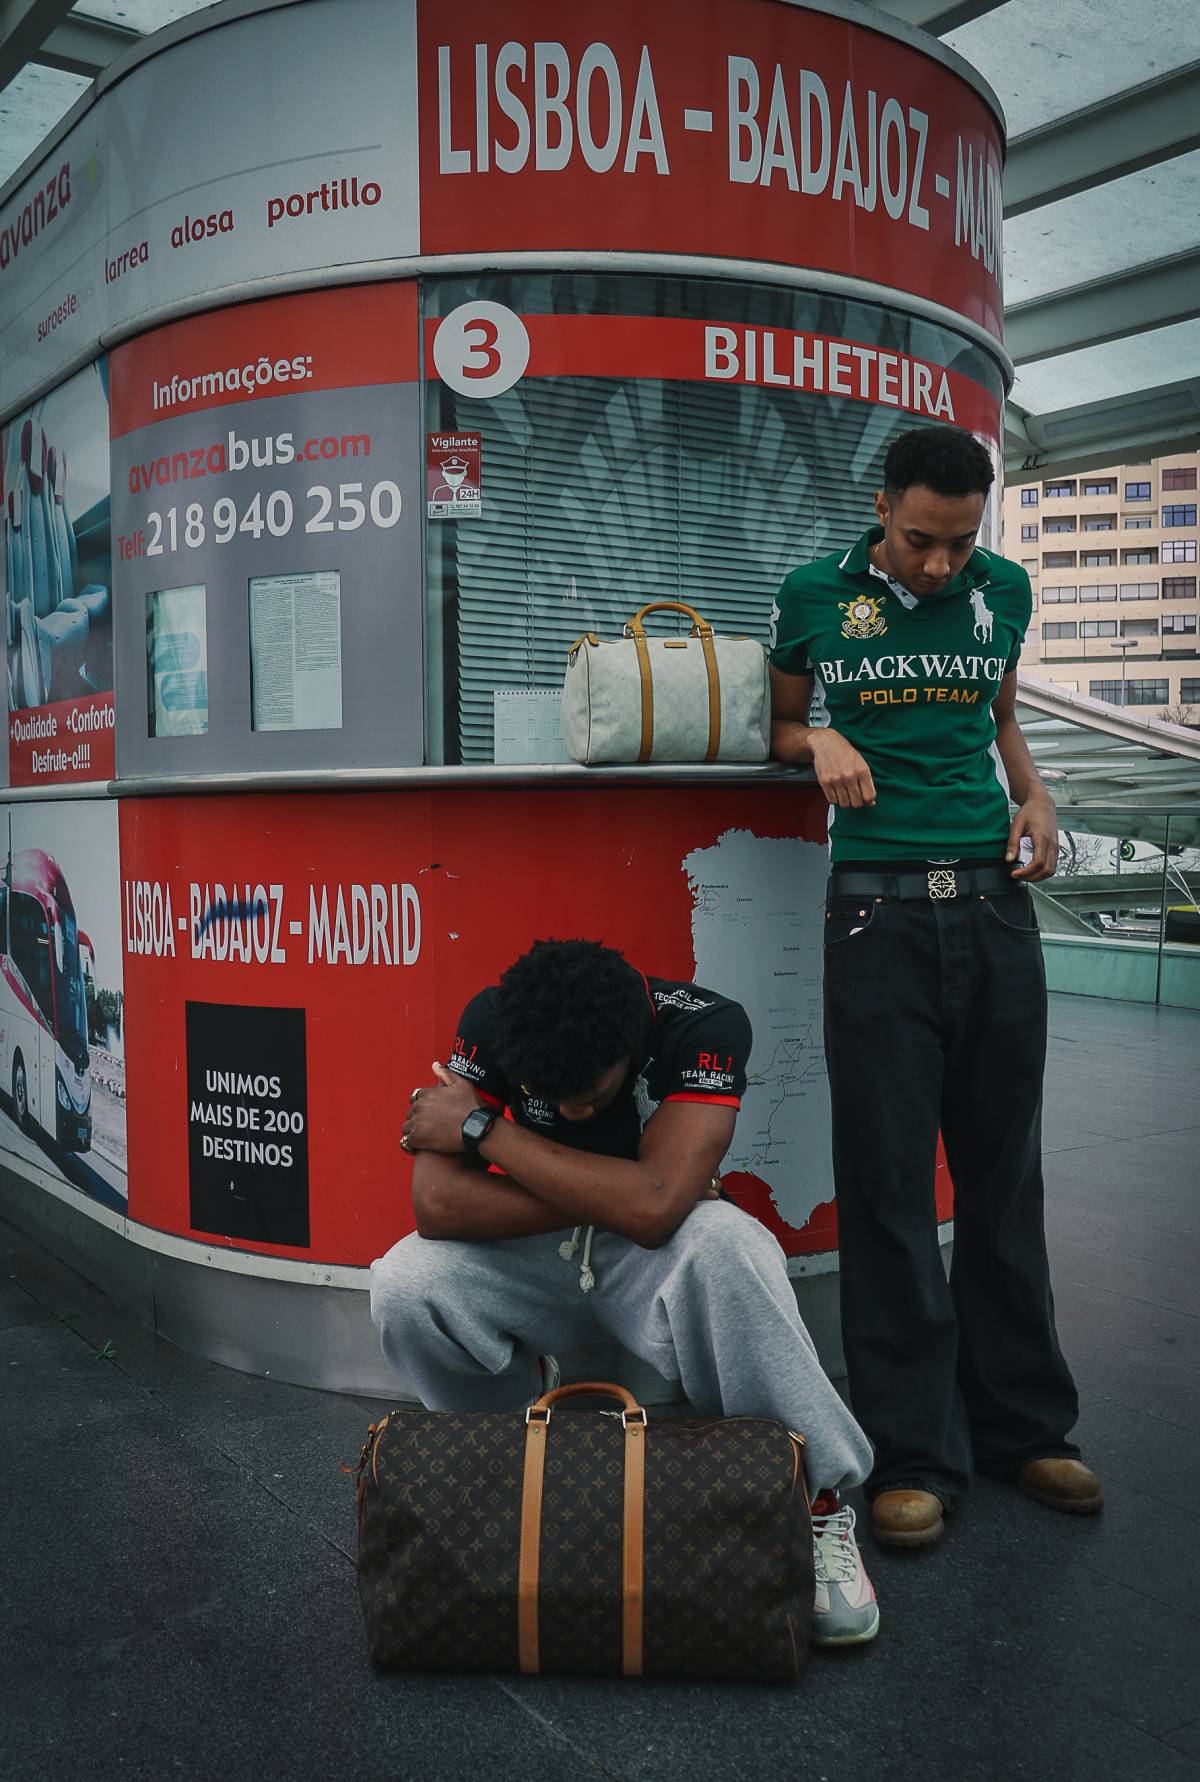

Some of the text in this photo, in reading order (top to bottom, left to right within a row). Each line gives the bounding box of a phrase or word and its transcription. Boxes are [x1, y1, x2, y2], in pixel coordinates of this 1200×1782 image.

[438, 41, 669, 175] LISBOA
[728, 55, 929, 230] BADAJOZ
[0, 161, 71, 269] avanza
[267, 178, 382, 227] portillo
[171, 209, 234, 249] alosa
[105, 240, 149, 284] larrea
[461, 318, 503, 380] 3
[153, 354, 313, 410] Informações:
[705, 326, 955, 421] BILHETEIRA
[128, 431, 371, 495] avanzabus.com
[431, 437, 478, 449] Vigilante
[461, 490, 479, 498] 24H
[146, 503, 206, 557] 218
[213, 490, 294, 544] 940
[305, 480, 402, 533] 250
[860, 688, 979, 706] POLO TEAM
[125, 880, 176, 958] LISBOA
[189, 882, 286, 963] BADAJOZ
[307, 883, 422, 965] MADRID
[205, 1069, 282, 1099] UNIMOS
[456, 1055, 486, 1078] RACING
[681, 1069, 707, 1079] TEAM
[190, 1101, 304, 1135] MAIS DE 200
[202, 1136, 293, 1168] DESTINOS
